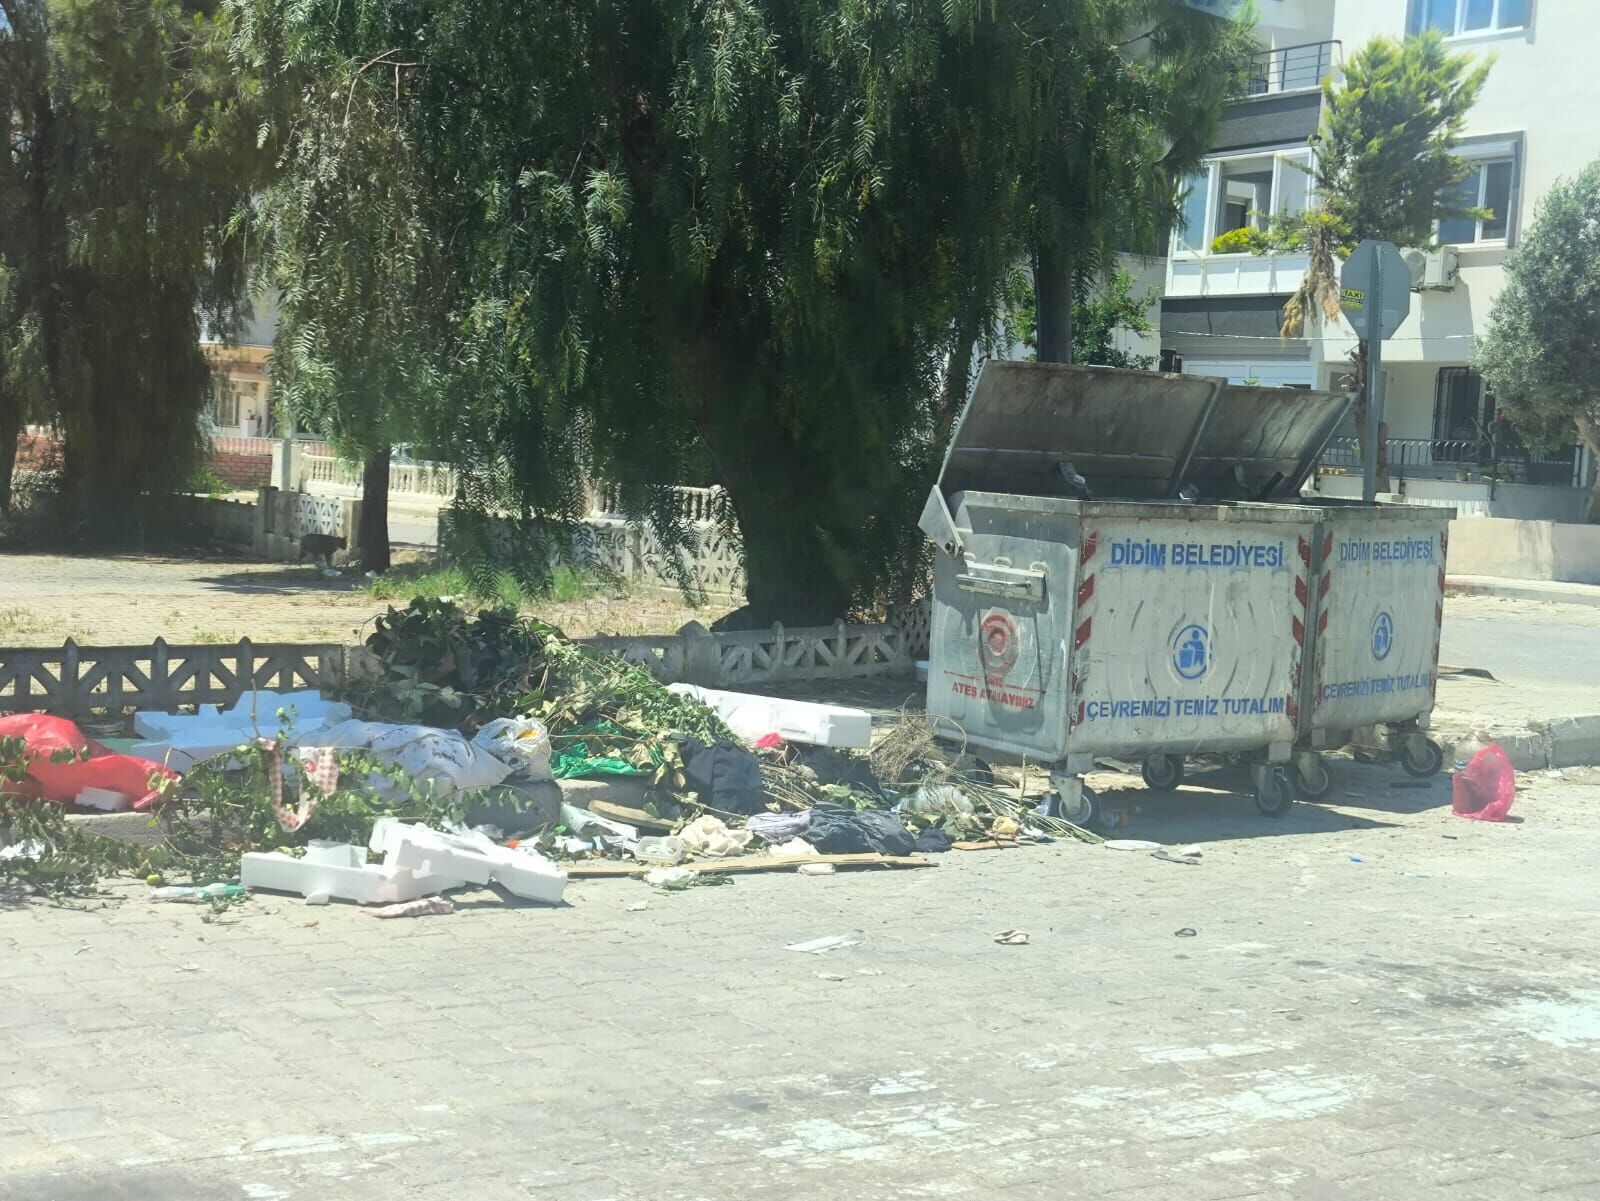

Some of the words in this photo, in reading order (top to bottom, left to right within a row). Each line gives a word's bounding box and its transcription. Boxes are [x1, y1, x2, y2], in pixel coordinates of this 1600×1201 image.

[1344, 290, 1362, 298] TAXI
[1111, 538, 1167, 566] DİDİM
[1171, 540, 1284, 567] BELEDİYESİ
[1340, 537, 1371, 561] DİDİM
[1373, 536, 1434, 561] BELEDİYESİ
[1086, 696, 1171, 721] ÇEVREMİZİ
[1175, 696, 1218, 716] TEMİZ
[1223, 697, 1285, 715] TUTALIM
